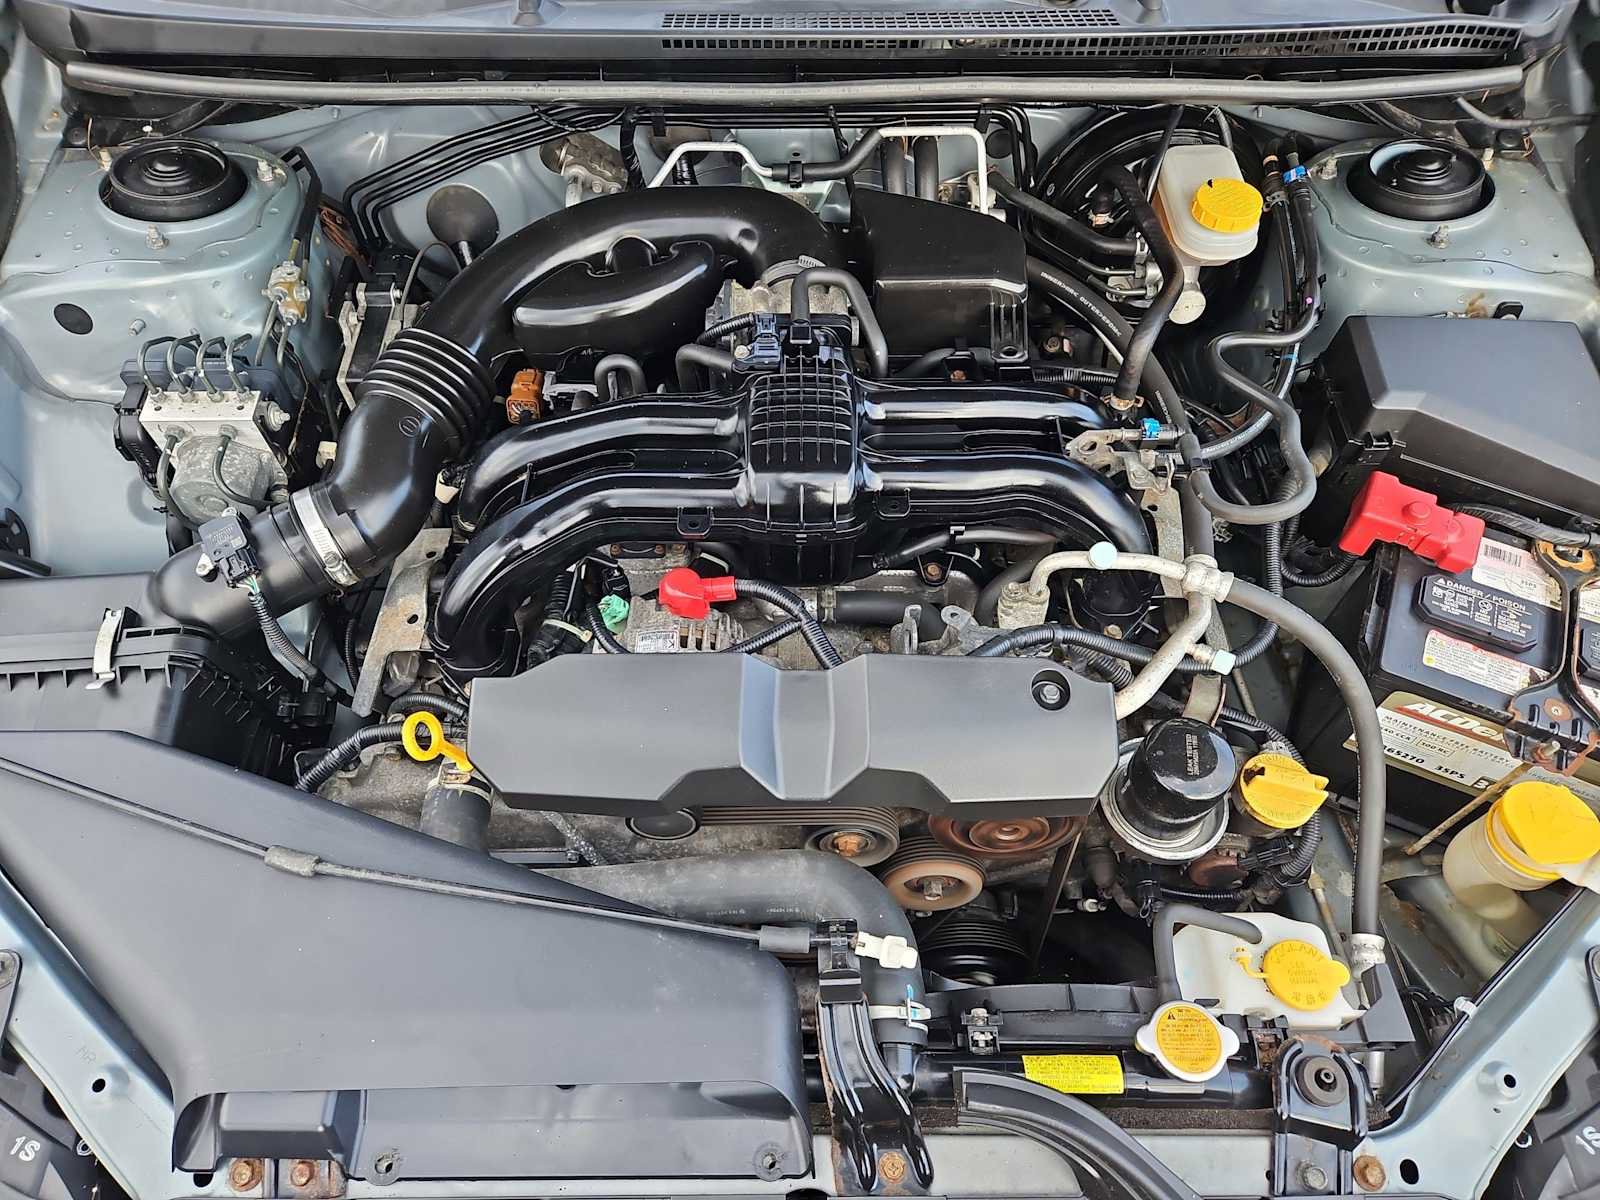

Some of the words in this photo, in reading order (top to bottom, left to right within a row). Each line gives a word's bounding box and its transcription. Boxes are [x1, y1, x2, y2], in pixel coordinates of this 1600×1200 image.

[1446, 580, 1484, 598] DANGER
[1492, 595, 1526, 611] POISON
[1384, 715, 1447, 741] MAINTENANCE
[1186, 757, 1194, 776] LEAK
